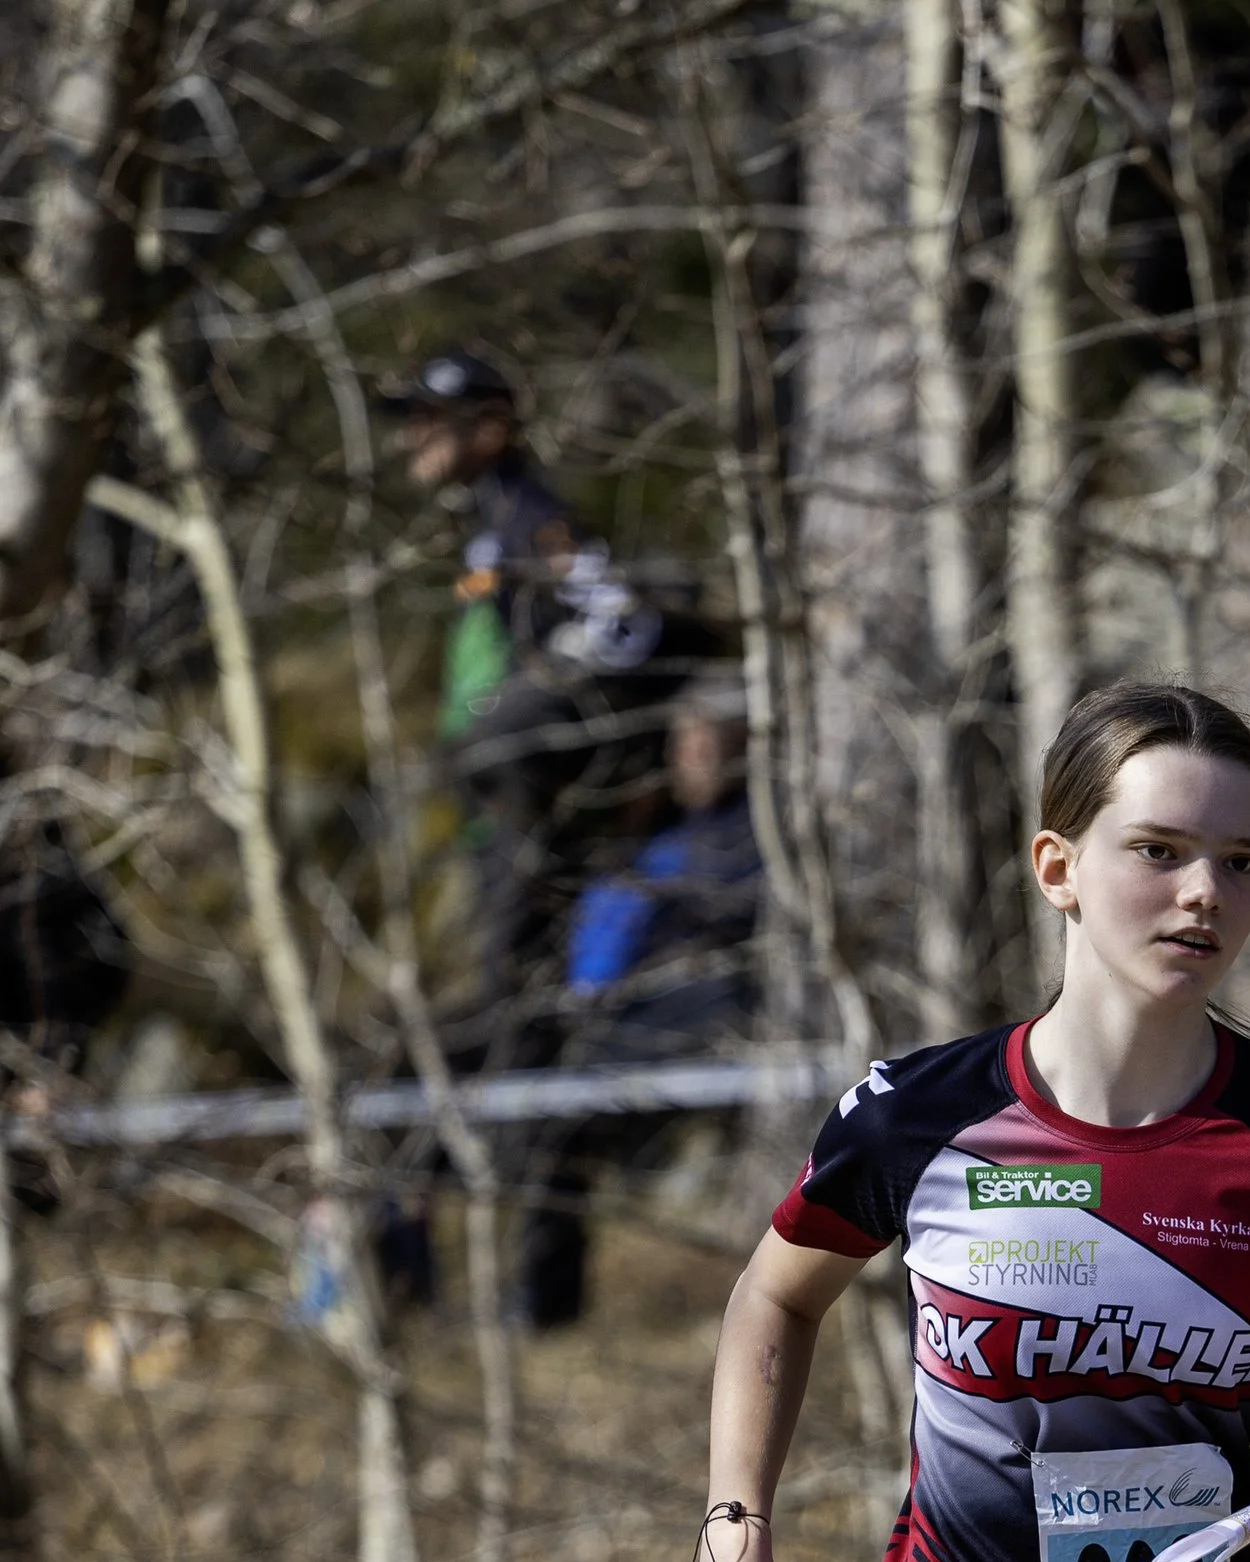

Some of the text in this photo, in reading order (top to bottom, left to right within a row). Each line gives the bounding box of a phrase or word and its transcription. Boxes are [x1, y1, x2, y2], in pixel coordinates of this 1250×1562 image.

[975, 1171, 1039, 1180] Bil & Traktor
[976, 1172, 1092, 1203] service
[1142, 1211, 1205, 1232] Svenska
[991, 1240, 1099, 1263] PROJEKT
[1157, 1231, 1210, 1247] Stigtomta
[1219, 1238, 1249, 1252] Vrena
[968, 1263, 1088, 1286] STYRNING
[920, 1303, 997, 1378] OK
[1051, 1484, 1165, 1517] NOREX
